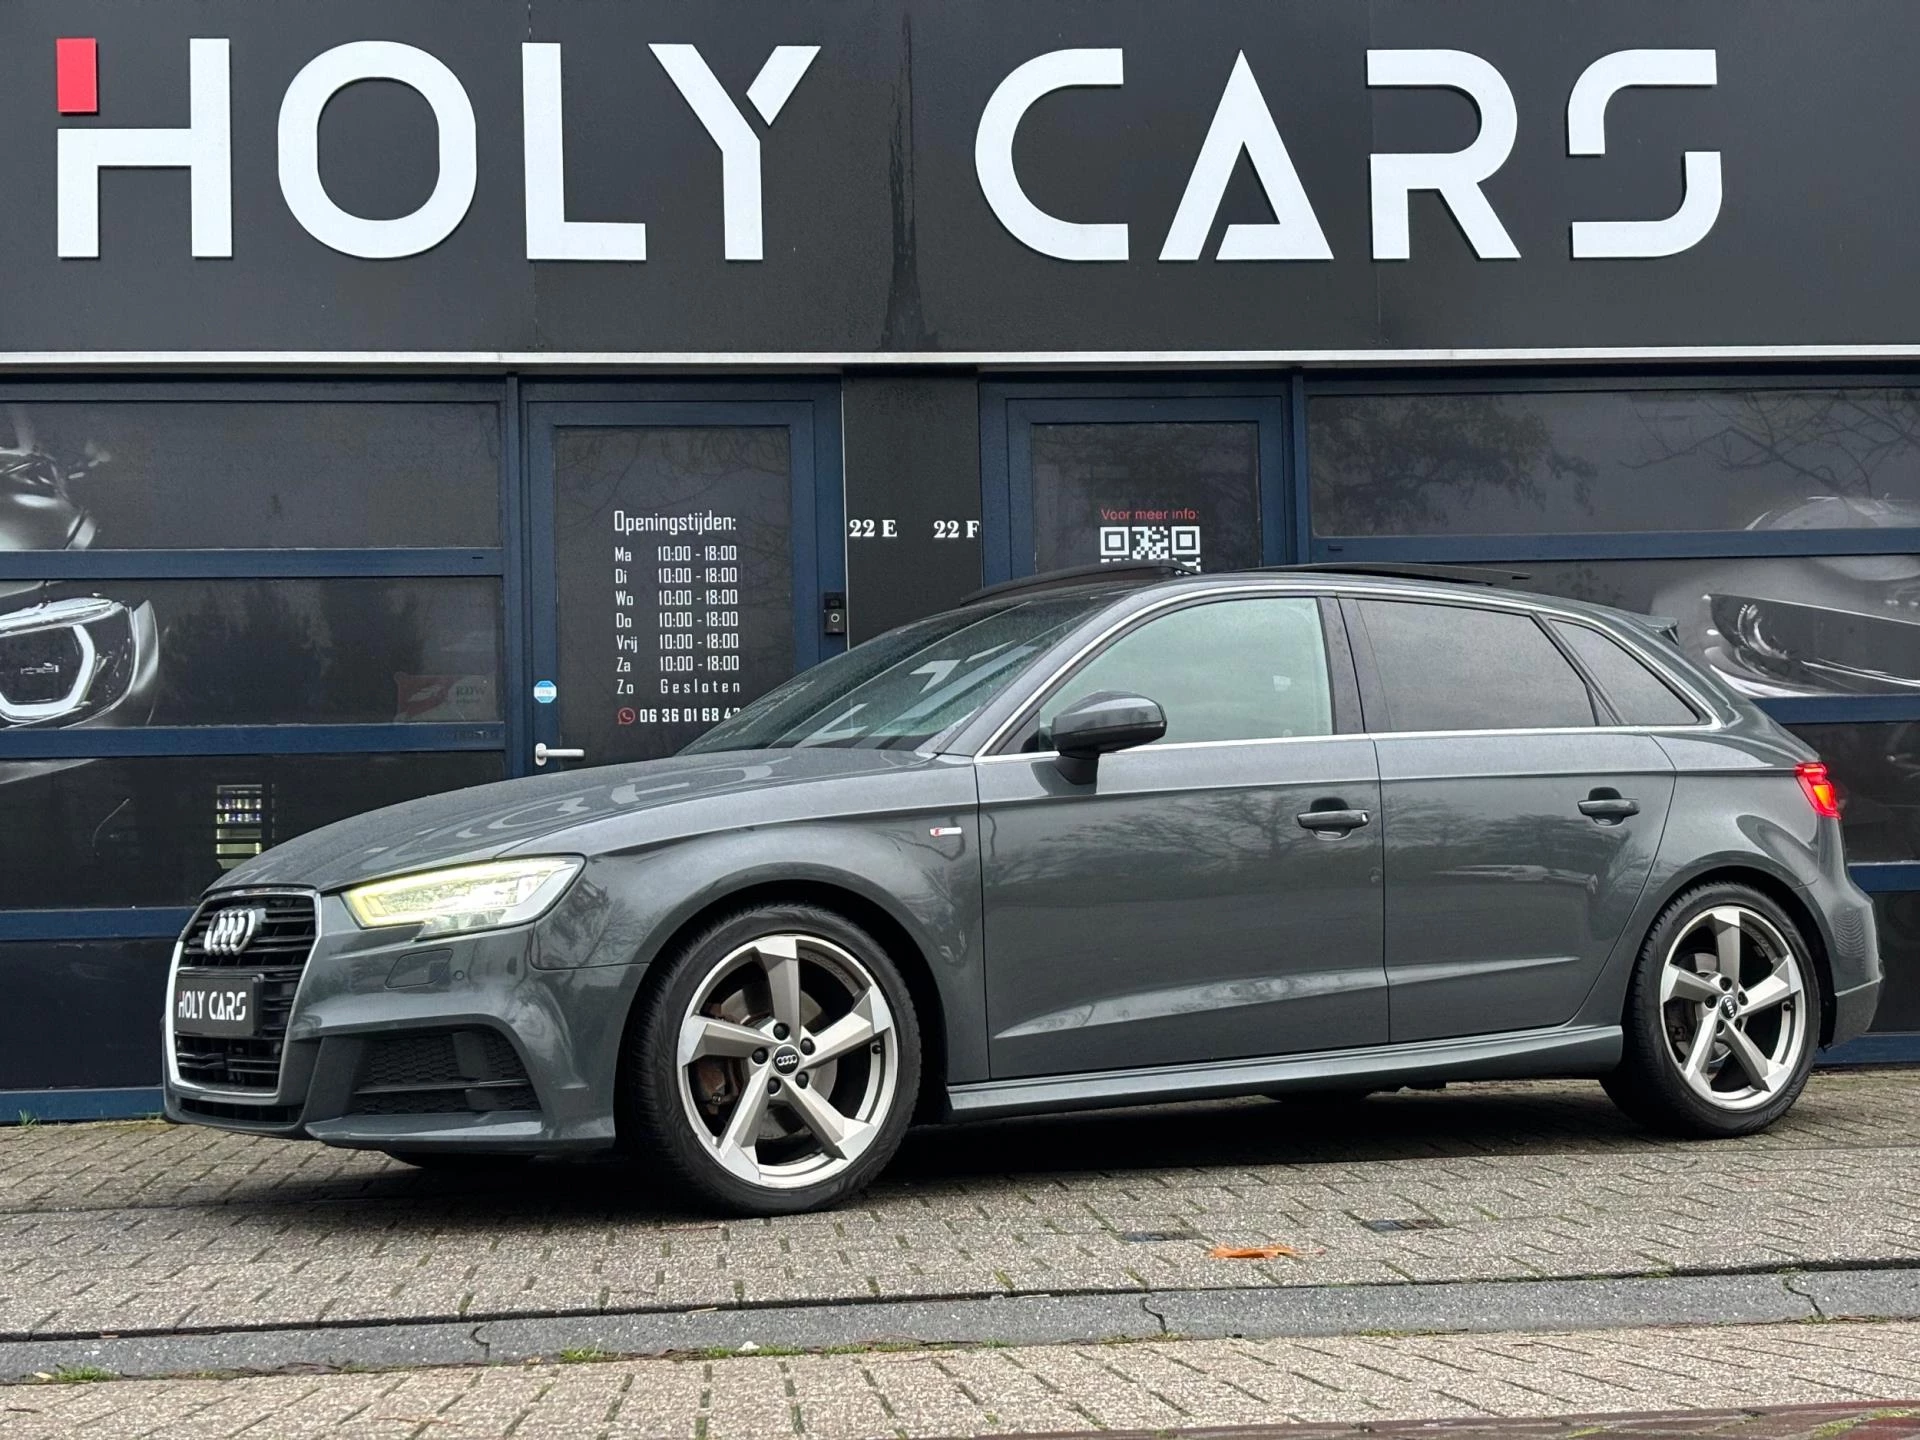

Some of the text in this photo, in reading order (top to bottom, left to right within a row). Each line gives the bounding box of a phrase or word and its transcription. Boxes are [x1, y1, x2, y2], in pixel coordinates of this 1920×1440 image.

[56, 36, 1723, 262] HOLY CARS
[613, 509, 737, 536] Openingstijden:
[1100, 507, 1199, 520] Voor meer info:
[849, 518, 898, 538] 22 E
[933, 520, 980, 539] 22 F
[615, 547, 632, 563] Ma
[657, 545, 691, 562] 10:00
[704, 545, 737, 562] 18:00
[615, 569, 627, 585] Di
[658, 567, 692, 584] 10:00
[705, 567, 738, 583] 18:00
[615, 590, 634, 606] Wo
[658, 589, 692, 606] 10:00
[705, 589, 738, 605] 18:00
[616, 612, 632, 629] Do
[659, 611, 693, 628] 10:00
[706, 611, 739, 627] 18:00
[616, 635, 638, 653] Vrij
[659, 633, 693, 650] 10:00
[706, 633, 739, 649] 18:00
[616, 657, 631, 673] Za
[660, 655, 693, 672] 10:00
[706, 655, 740, 671] 18:00
[616, 678, 740, 695] Zo Gesloten
[640, 708, 657, 723] 06
[661, 708, 680, 722] 36
[683, 708, 698, 722] 01
[701, 707, 720, 722] 68
[178, 991, 247, 1022] HOLY CARS
